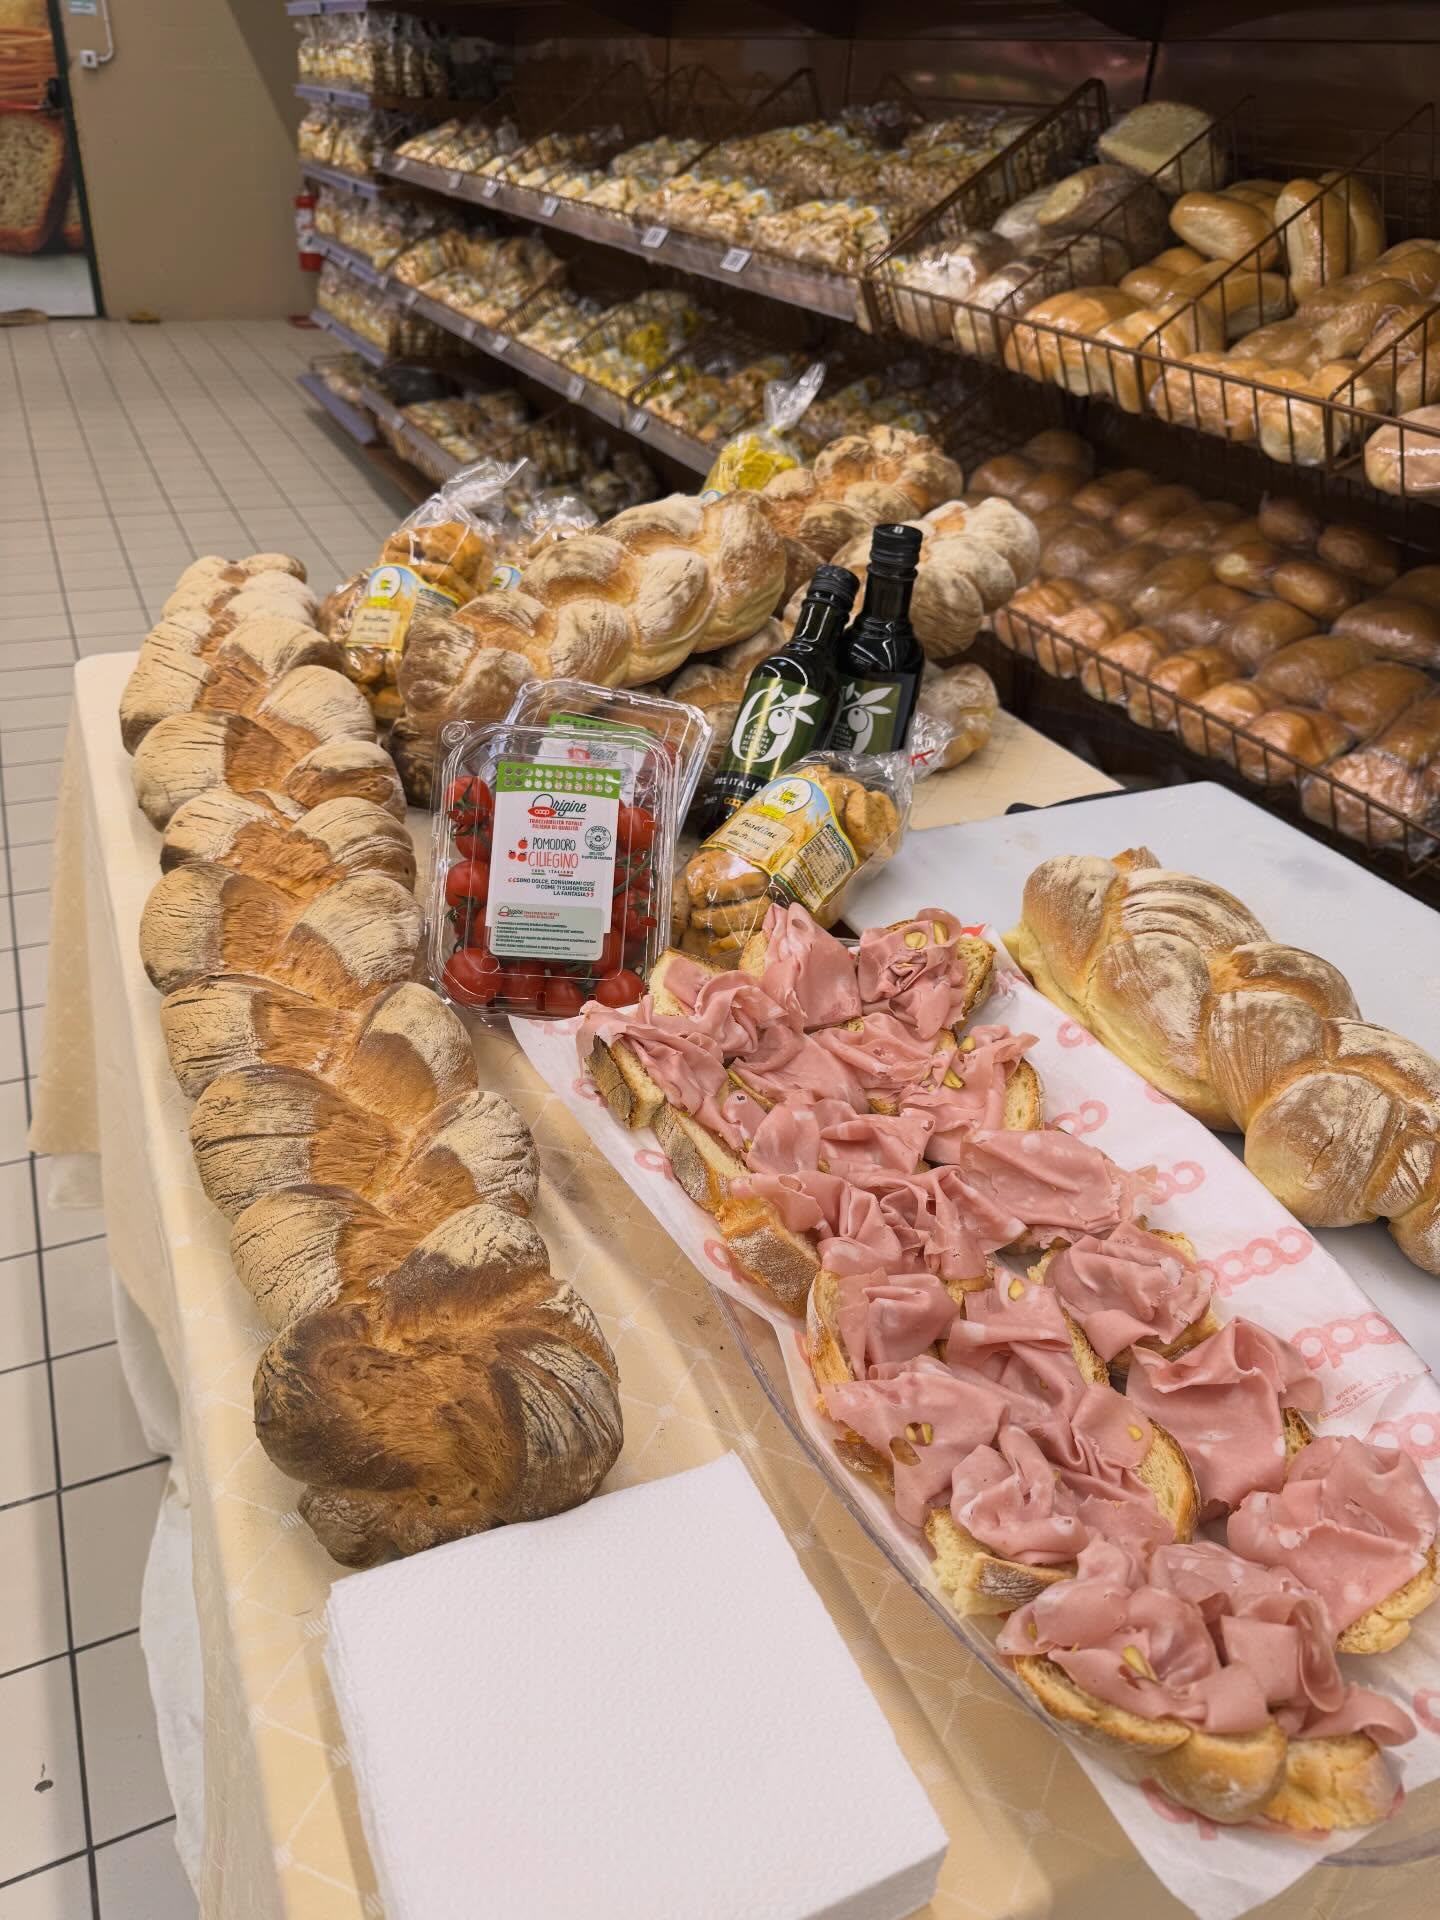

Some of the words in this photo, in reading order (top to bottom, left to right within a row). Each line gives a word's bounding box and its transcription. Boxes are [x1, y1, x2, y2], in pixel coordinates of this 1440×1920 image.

[729, 777, 763, 791] ITALIA
[532, 793, 587, 817] Origine
[534, 809, 550, 817] coop
[532, 837, 577, 851] POMODORO
[528, 851, 579, 869] CILIEGINO
